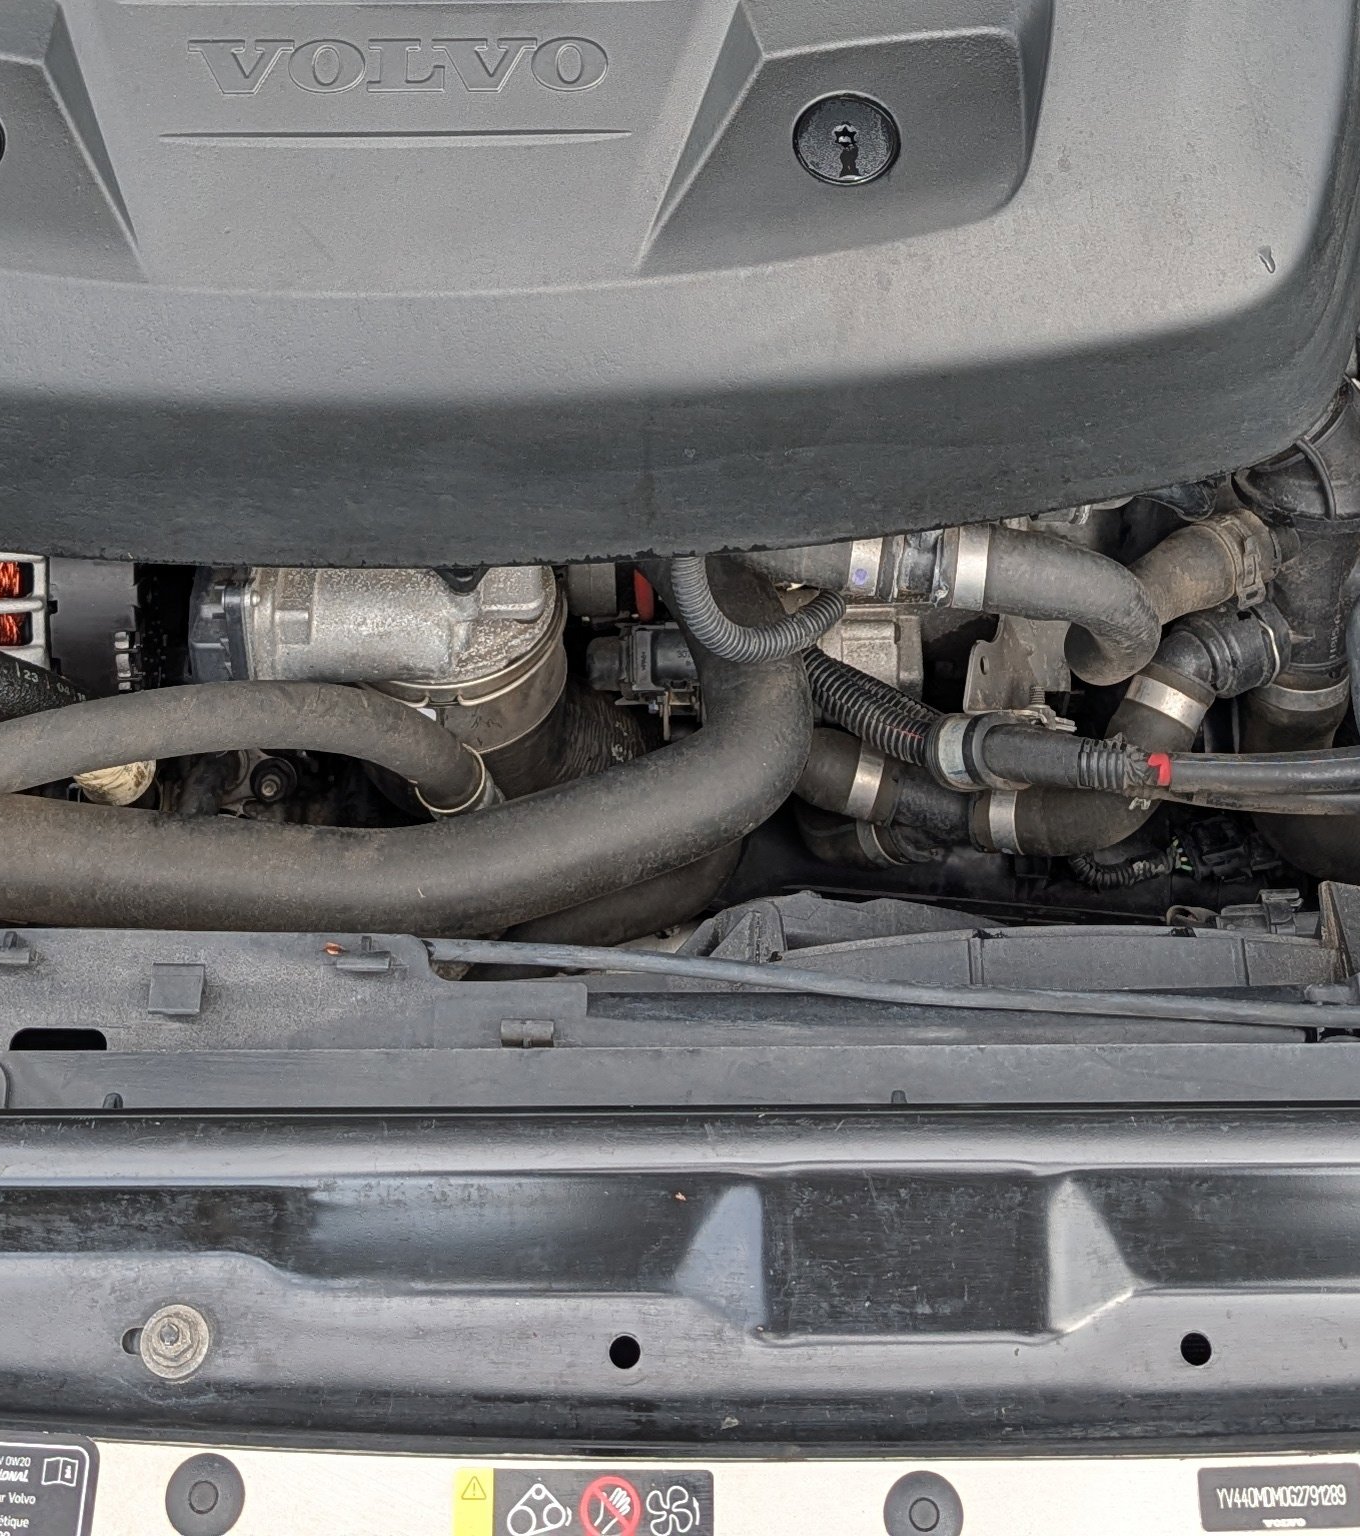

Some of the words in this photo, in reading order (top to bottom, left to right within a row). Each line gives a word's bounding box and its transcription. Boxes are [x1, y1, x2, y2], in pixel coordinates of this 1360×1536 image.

[187, 36, 609, 95] VOLVO
[23, 669, 40, 684] 23
[6, 1456, 32, 1467] 0W20
[8, 1492, 36, 1504] Volvo
[1216, 1484, 1346, 1509] YV440MDM0G2791289
